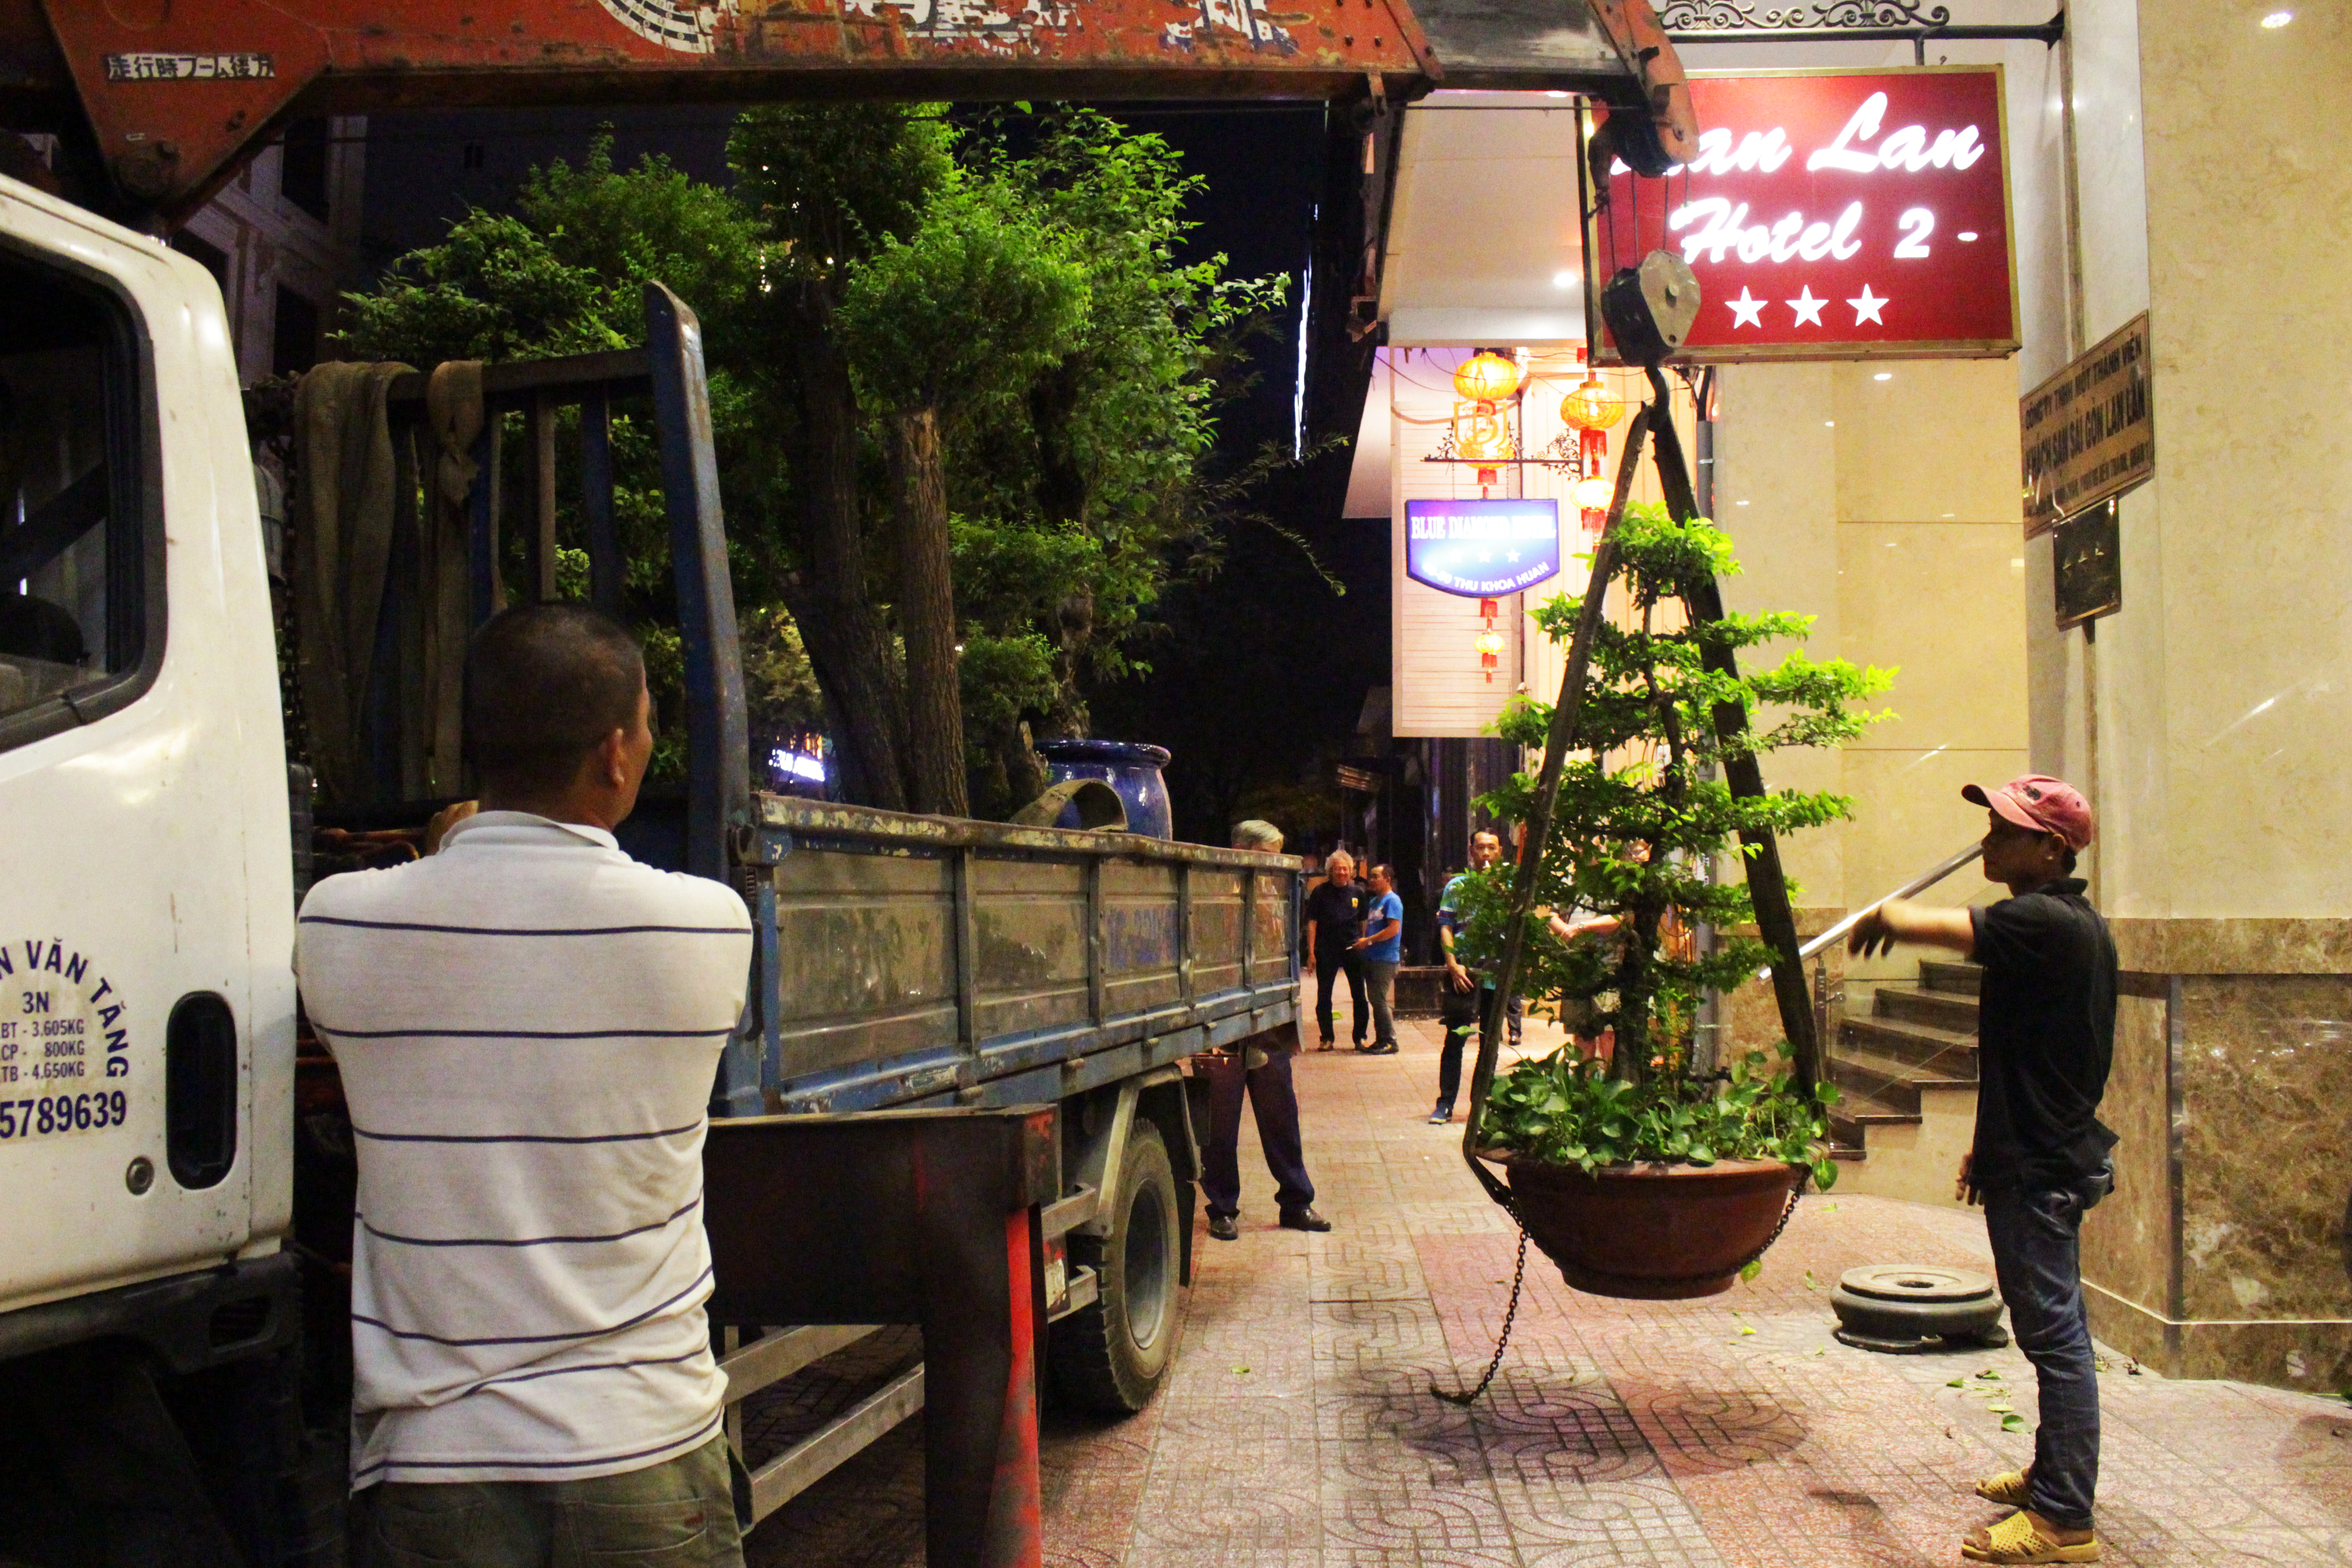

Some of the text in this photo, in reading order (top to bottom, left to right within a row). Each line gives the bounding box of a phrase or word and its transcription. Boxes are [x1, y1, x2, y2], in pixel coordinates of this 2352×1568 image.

[1807, 92, 1984, 173] Lan
[1670, 197, 1936, 264] Hotel 2
[1411, 516, 1446, 539] BLUE
[1448, 516, 1510, 539] DIAMOND
[1454, 576, 1478, 591] THU
[1481, 578, 1516, 591] KHOA
[1516, 562, 1550, 585] HUAN
[23, 991, 49, 1014] 3N
[25, 936, 89, 985] VĂN
[90, 977, 129, 1077] TĂNG
[32, 1019, 85, 1037] 3.605KG
[44, 1040, 85, 1058] 800KG
[32, 1061, 85, 1080] 4.650KG
[0, 1090, 127, 1139] 5789639
